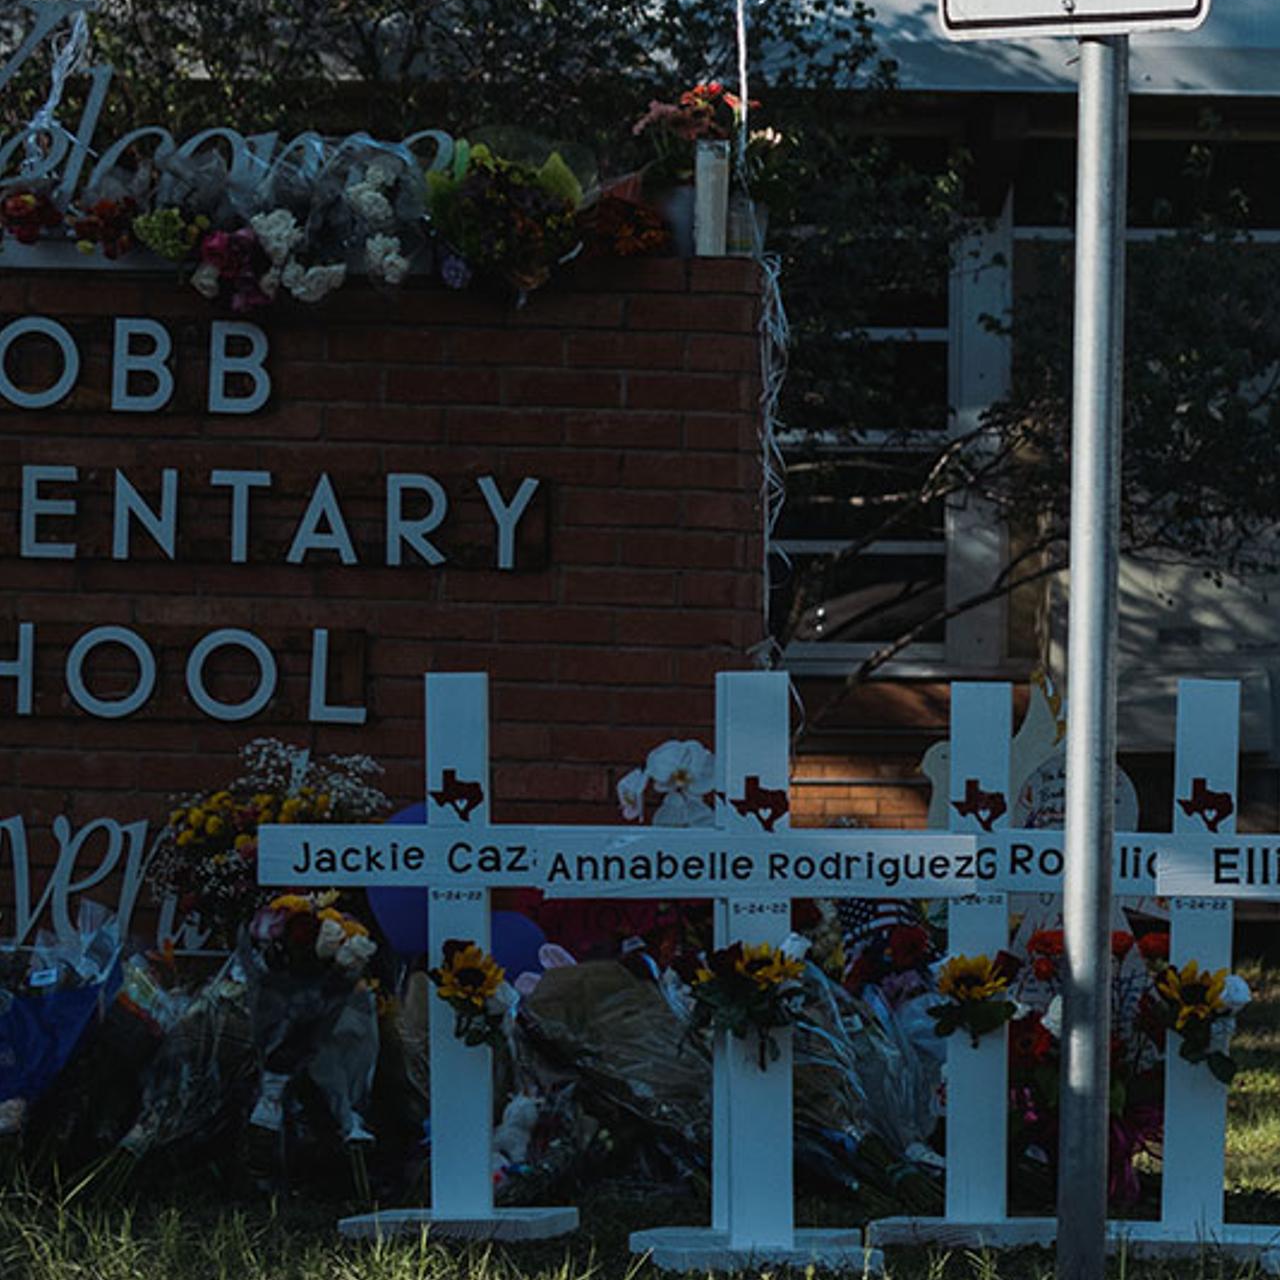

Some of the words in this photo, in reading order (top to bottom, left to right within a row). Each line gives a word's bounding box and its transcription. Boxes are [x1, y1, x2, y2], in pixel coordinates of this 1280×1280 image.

[0, 316, 272, 414] OBB
[20, 466, 540, 569] ENTARY
[293, 842, 424, 874] Jackie
[448, 842, 537, 874] Caz
[549, 851, 753, 882] Annabelle
[769, 848, 976, 886] Rodriguez
